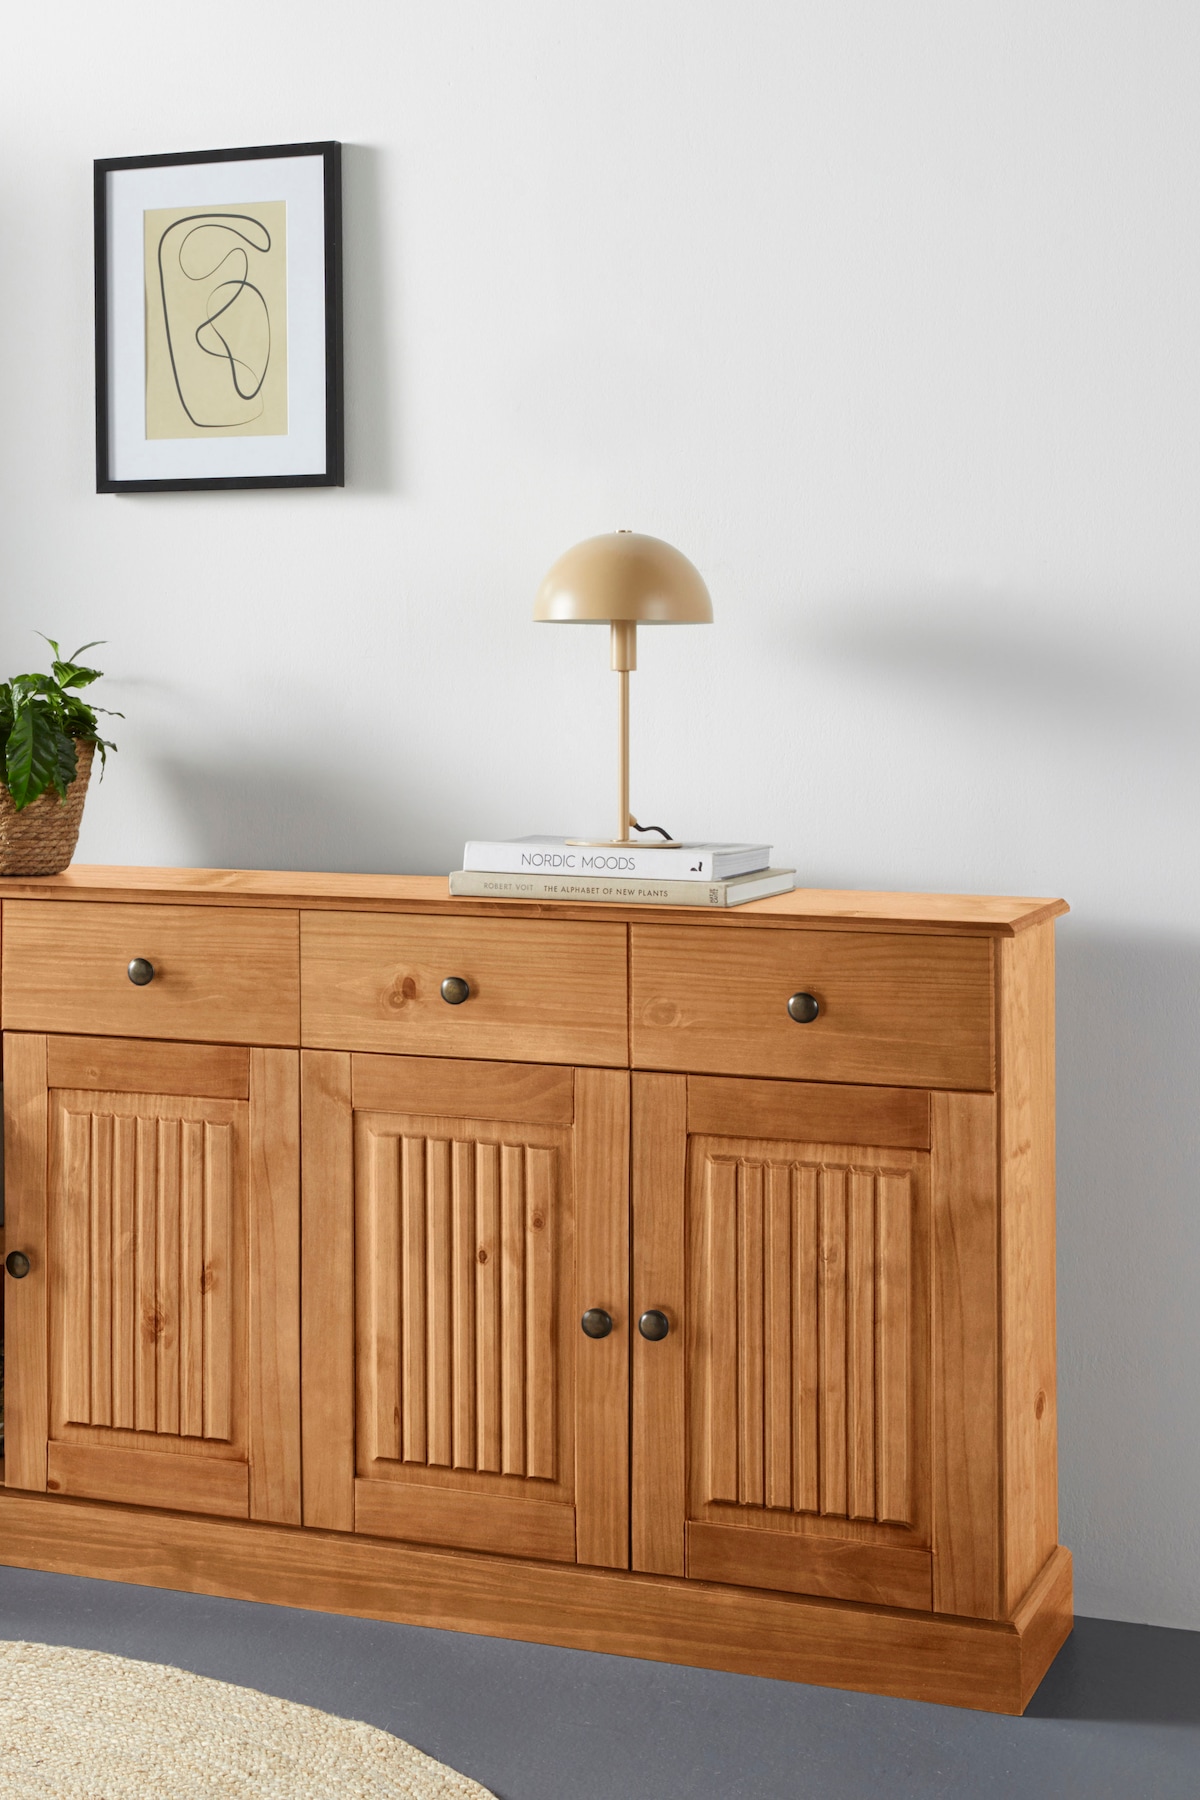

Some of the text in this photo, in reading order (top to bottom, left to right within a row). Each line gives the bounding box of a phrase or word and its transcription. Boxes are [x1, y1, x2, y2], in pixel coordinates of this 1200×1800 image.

[521, 853, 636, 871] NORDIC MOODS
[483, 882, 669, 898] ROBERT VOIT THE ALPHABET OF NEW PLANTS
